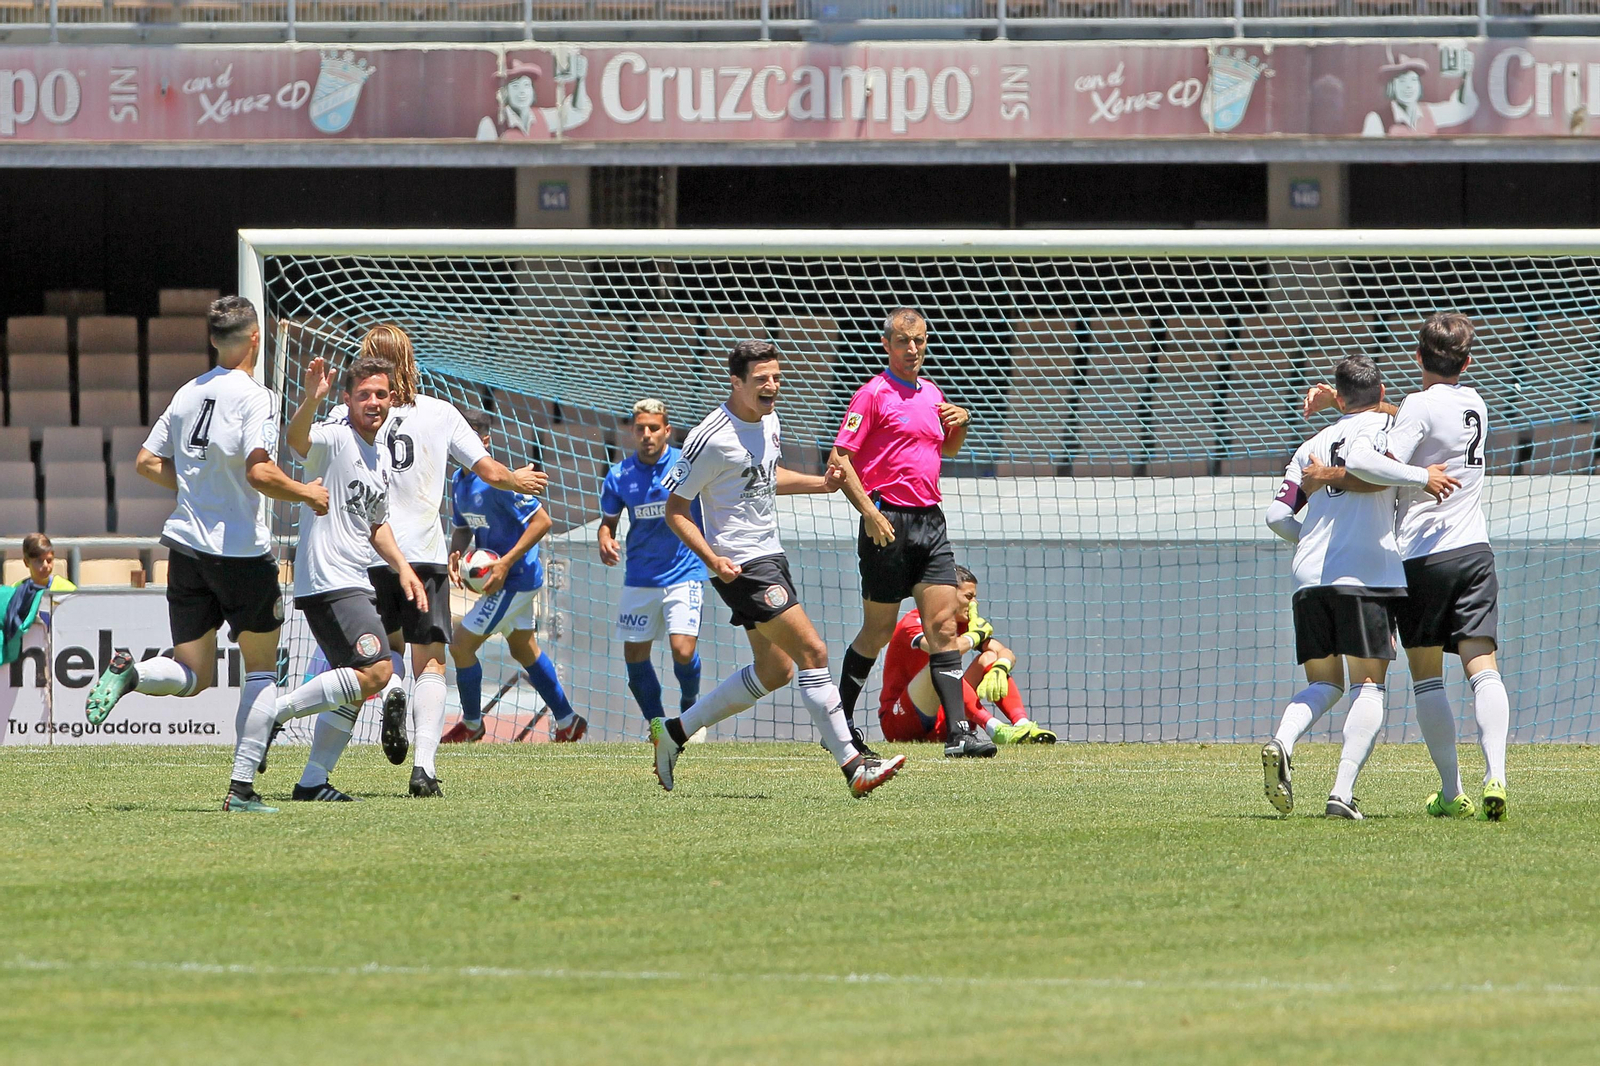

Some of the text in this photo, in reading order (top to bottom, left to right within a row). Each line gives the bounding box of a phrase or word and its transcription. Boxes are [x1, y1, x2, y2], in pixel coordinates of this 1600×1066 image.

[109, 66, 139, 124] SIN
[197, 90, 271, 125] Xerez
[276, 80, 310, 110] CD
[602, 51, 973, 134] Cruzcampo
[1001, 64, 1031, 121] SIN
[1088, 78, 1202, 124] Xerez CD
[188, 398, 216, 460] 4
[384, 416, 415, 473] 6
[1463, 409, 1483, 468] 2
[1276, 482, 1290, 498] C
[8, 719, 28, 734] Tu
[34, 719, 162, 738] aseguradora
